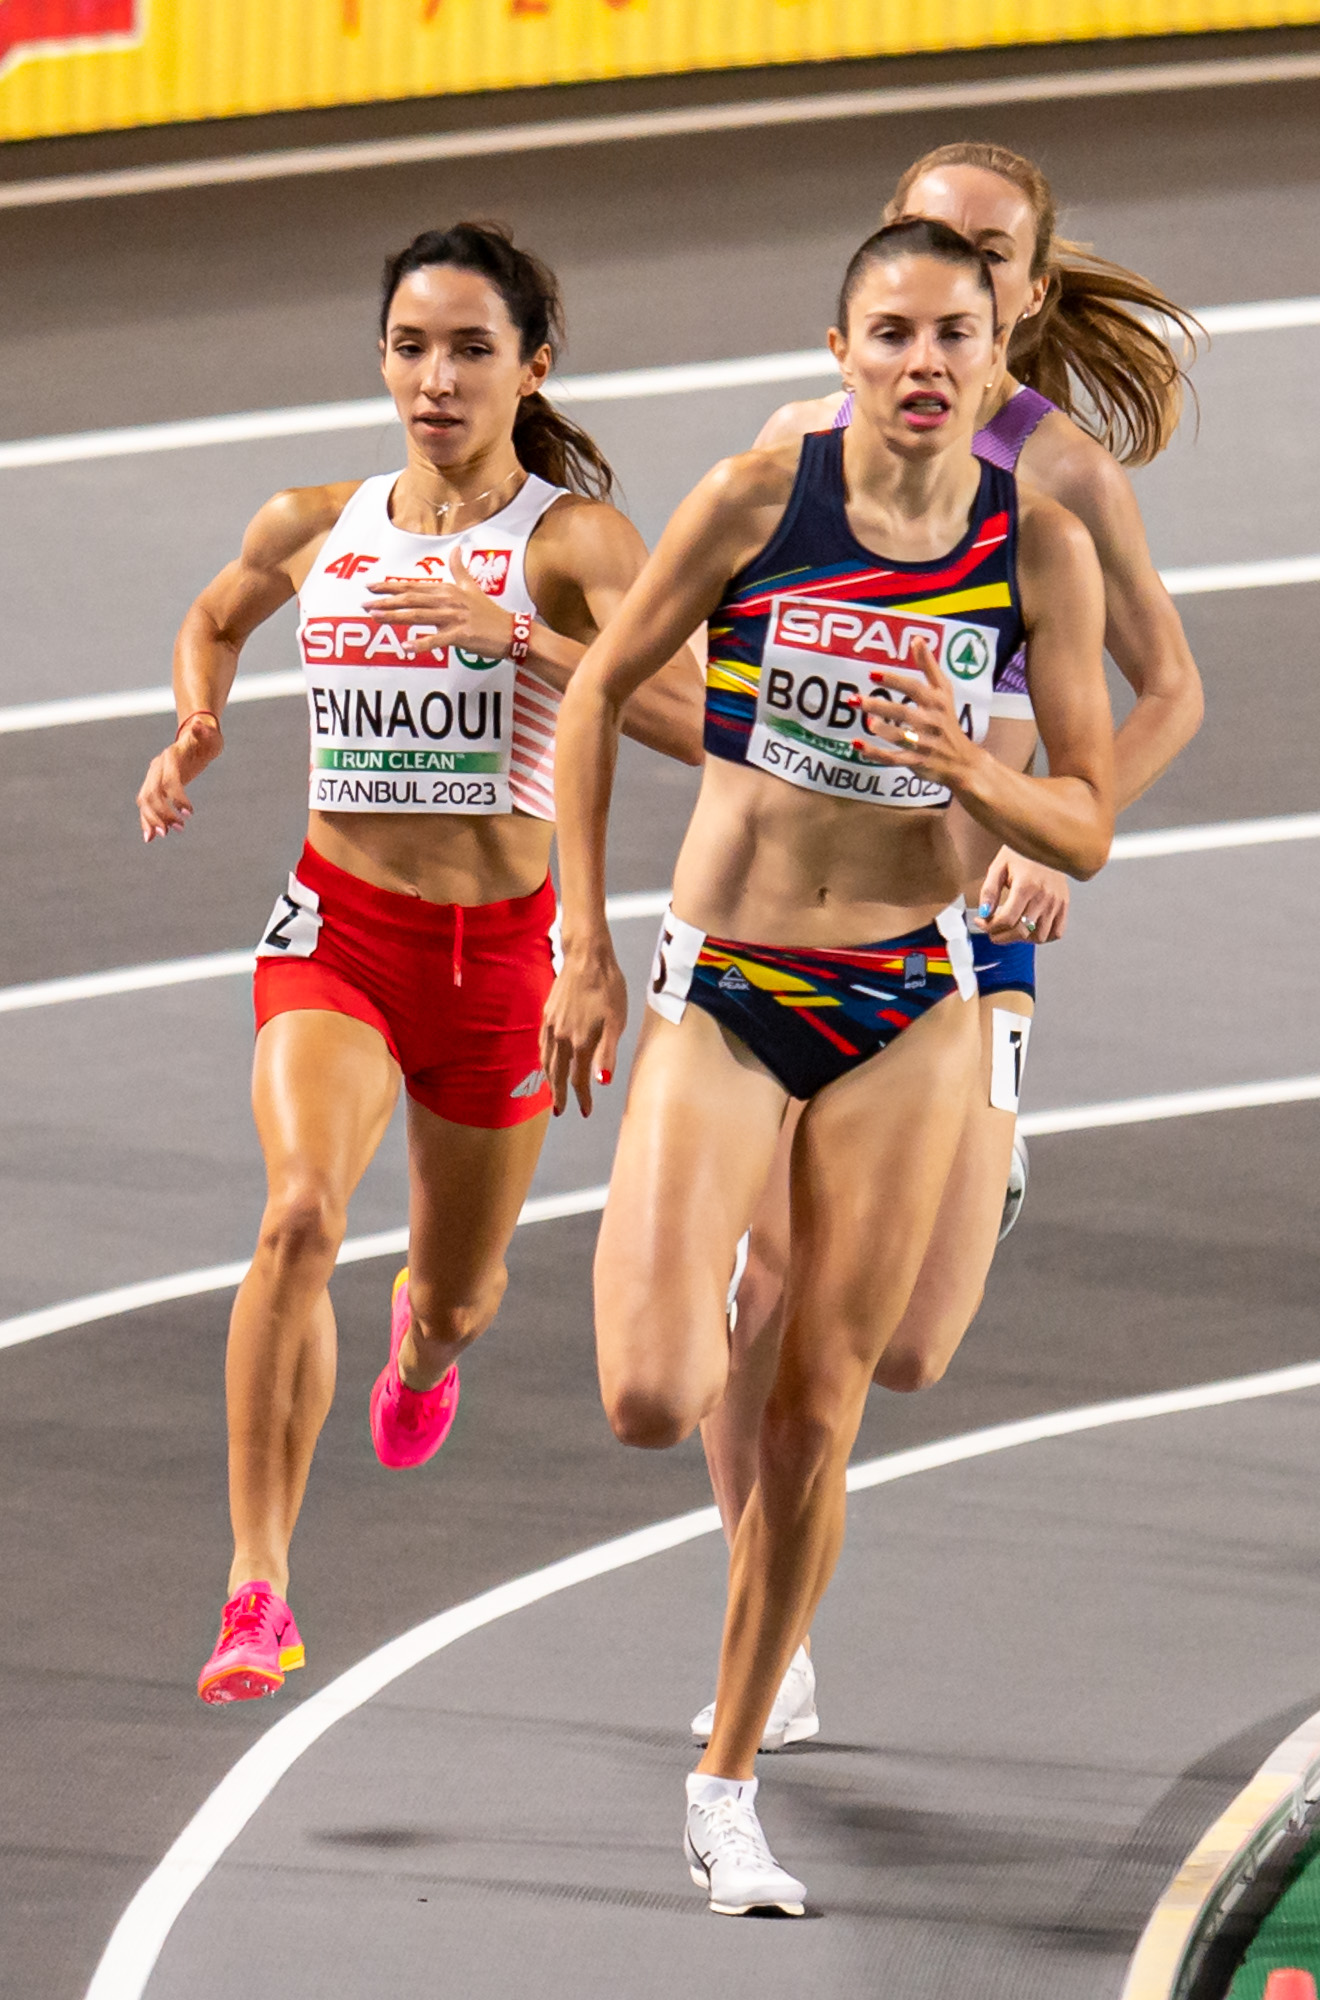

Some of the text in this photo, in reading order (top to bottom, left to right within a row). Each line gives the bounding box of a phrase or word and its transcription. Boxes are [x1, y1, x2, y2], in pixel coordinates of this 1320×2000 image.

[304, 622, 445, 662] SPAR
[779, 609, 939, 661] SPAR
[312, 687, 502, 740] ENNAOUI
[333, 751, 338, 767] I
[342, 751, 383, 769] RUN
[762, 739, 884, 797] ISTANBUL
[432, 781, 496, 805] 2023
